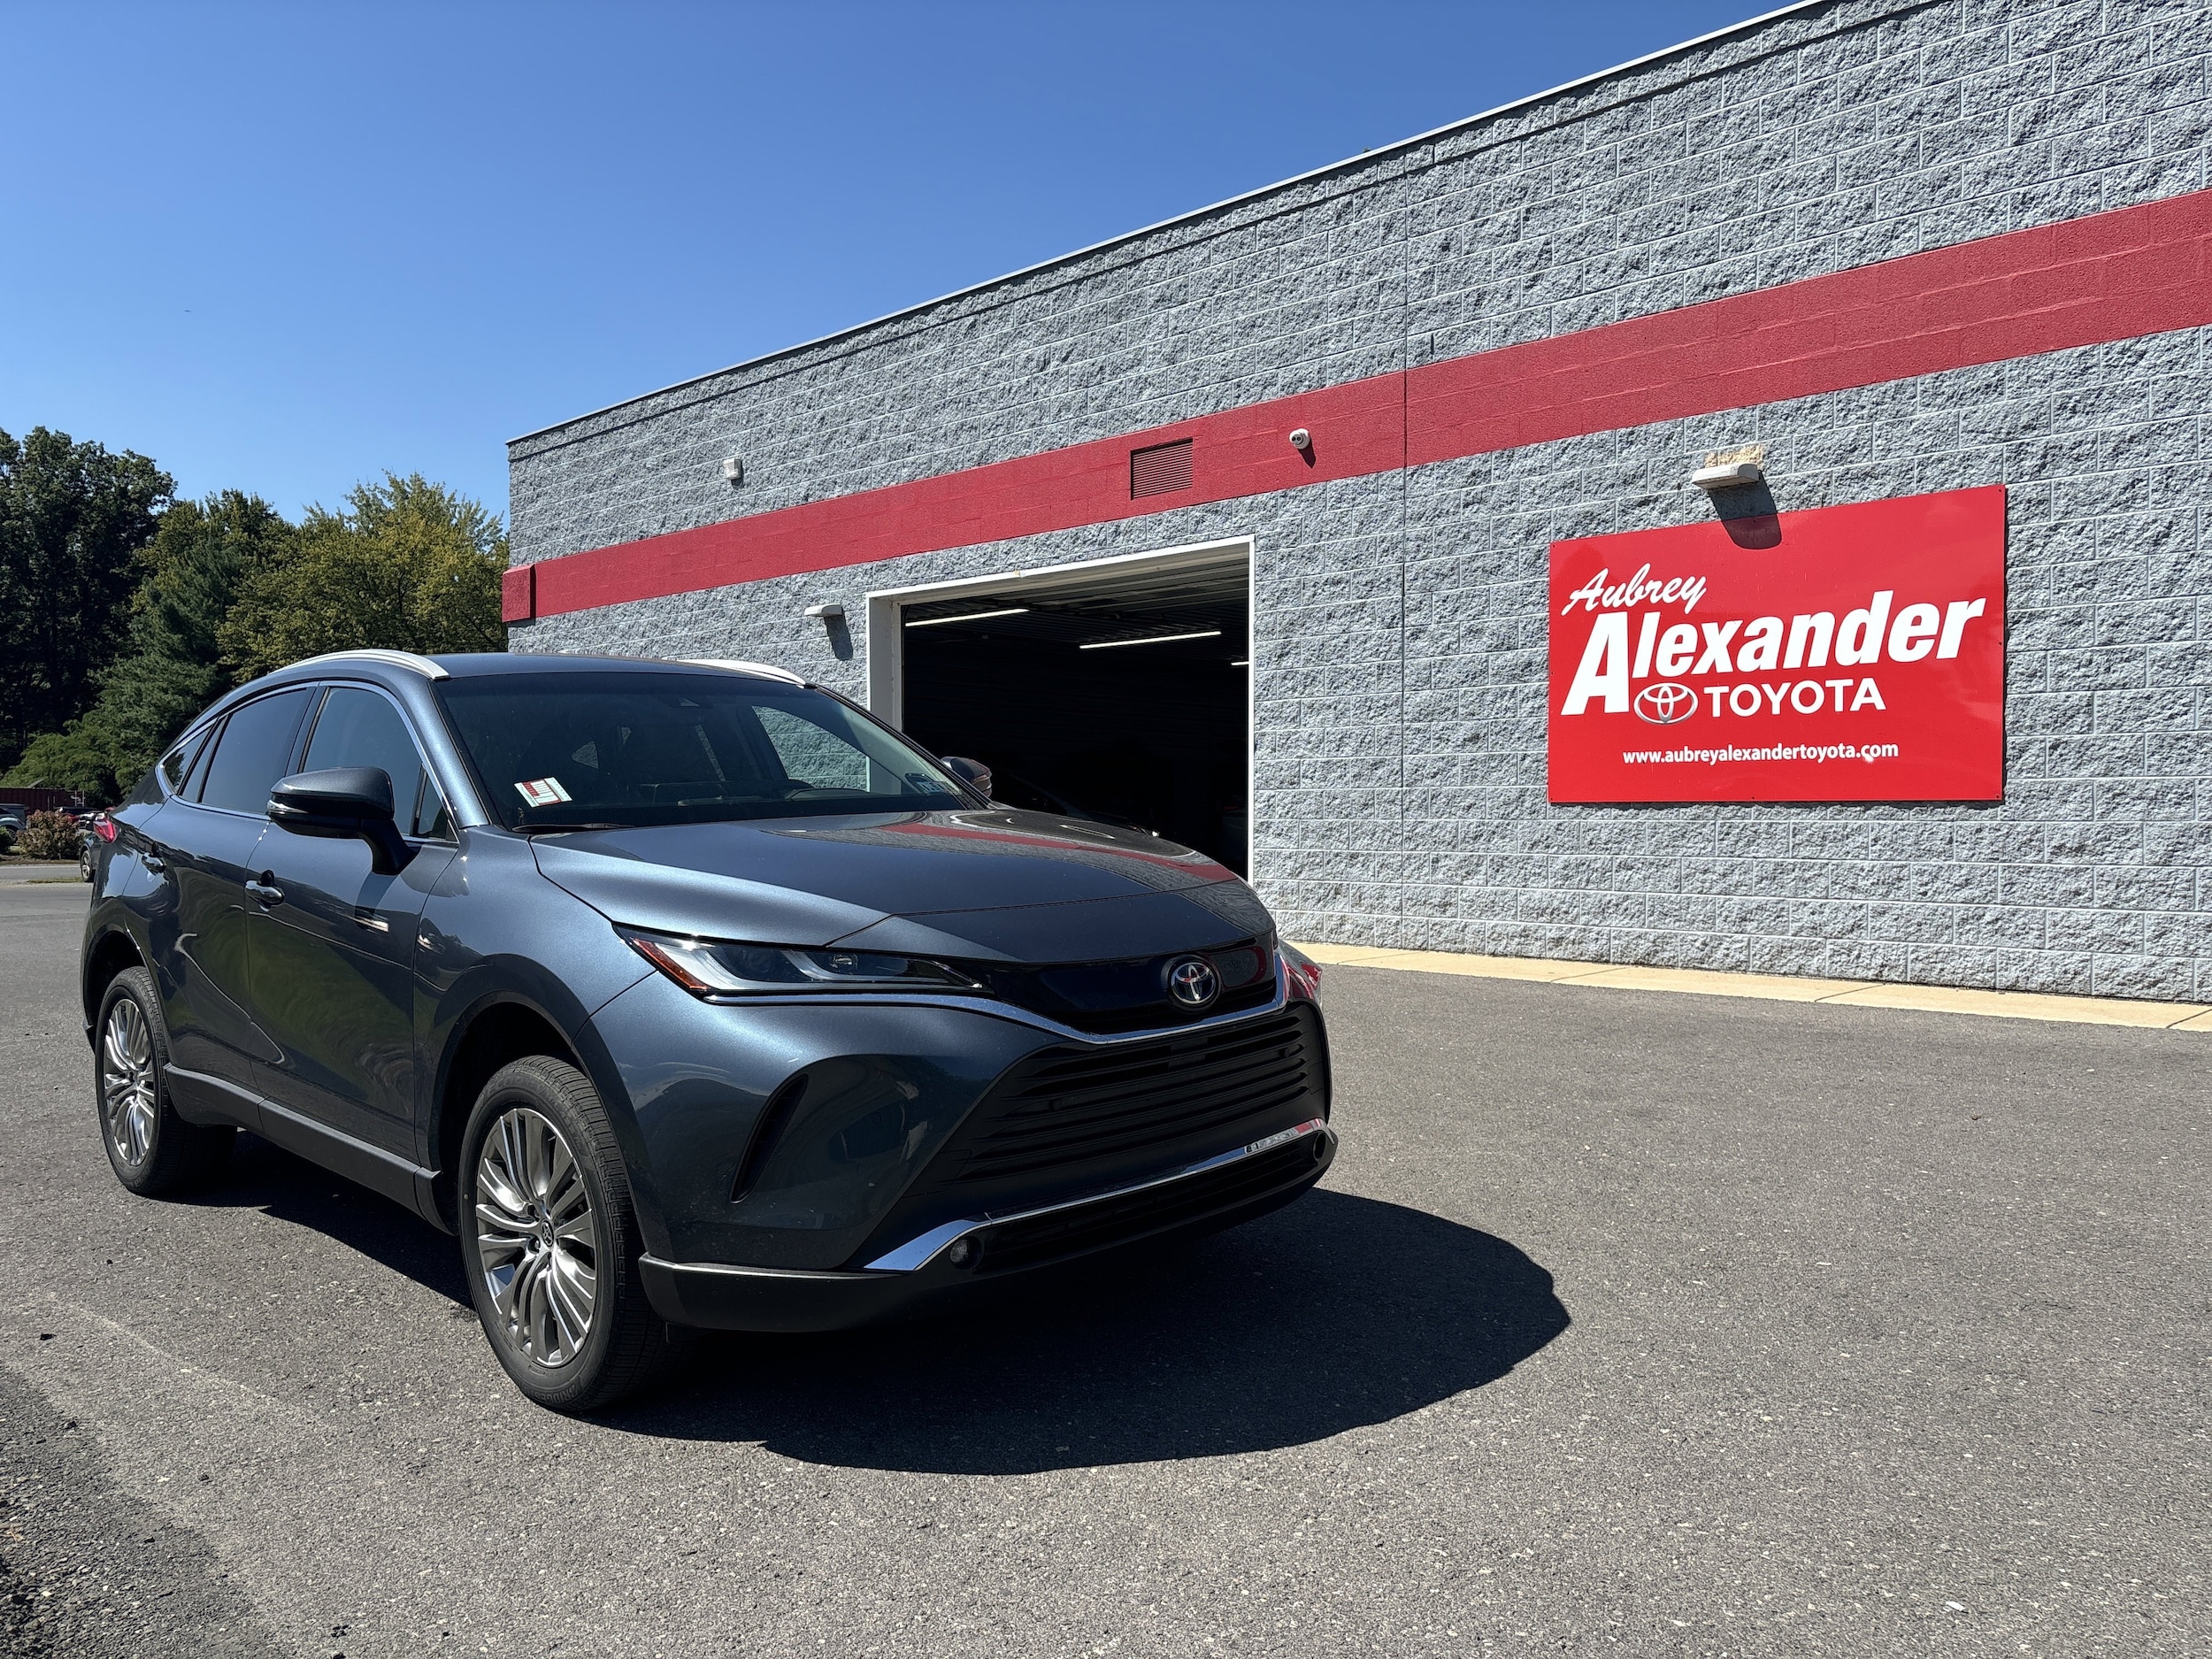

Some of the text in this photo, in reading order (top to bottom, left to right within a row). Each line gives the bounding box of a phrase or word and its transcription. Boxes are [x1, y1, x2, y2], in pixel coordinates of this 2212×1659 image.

[1562, 563, 1707, 616] Aubrey
[1561, 590, 1986, 716] Alexander
[1704, 678, 1886, 718] TOYOTA
[1623, 742, 1899, 766] www.aubreyalexandertoyota.com
